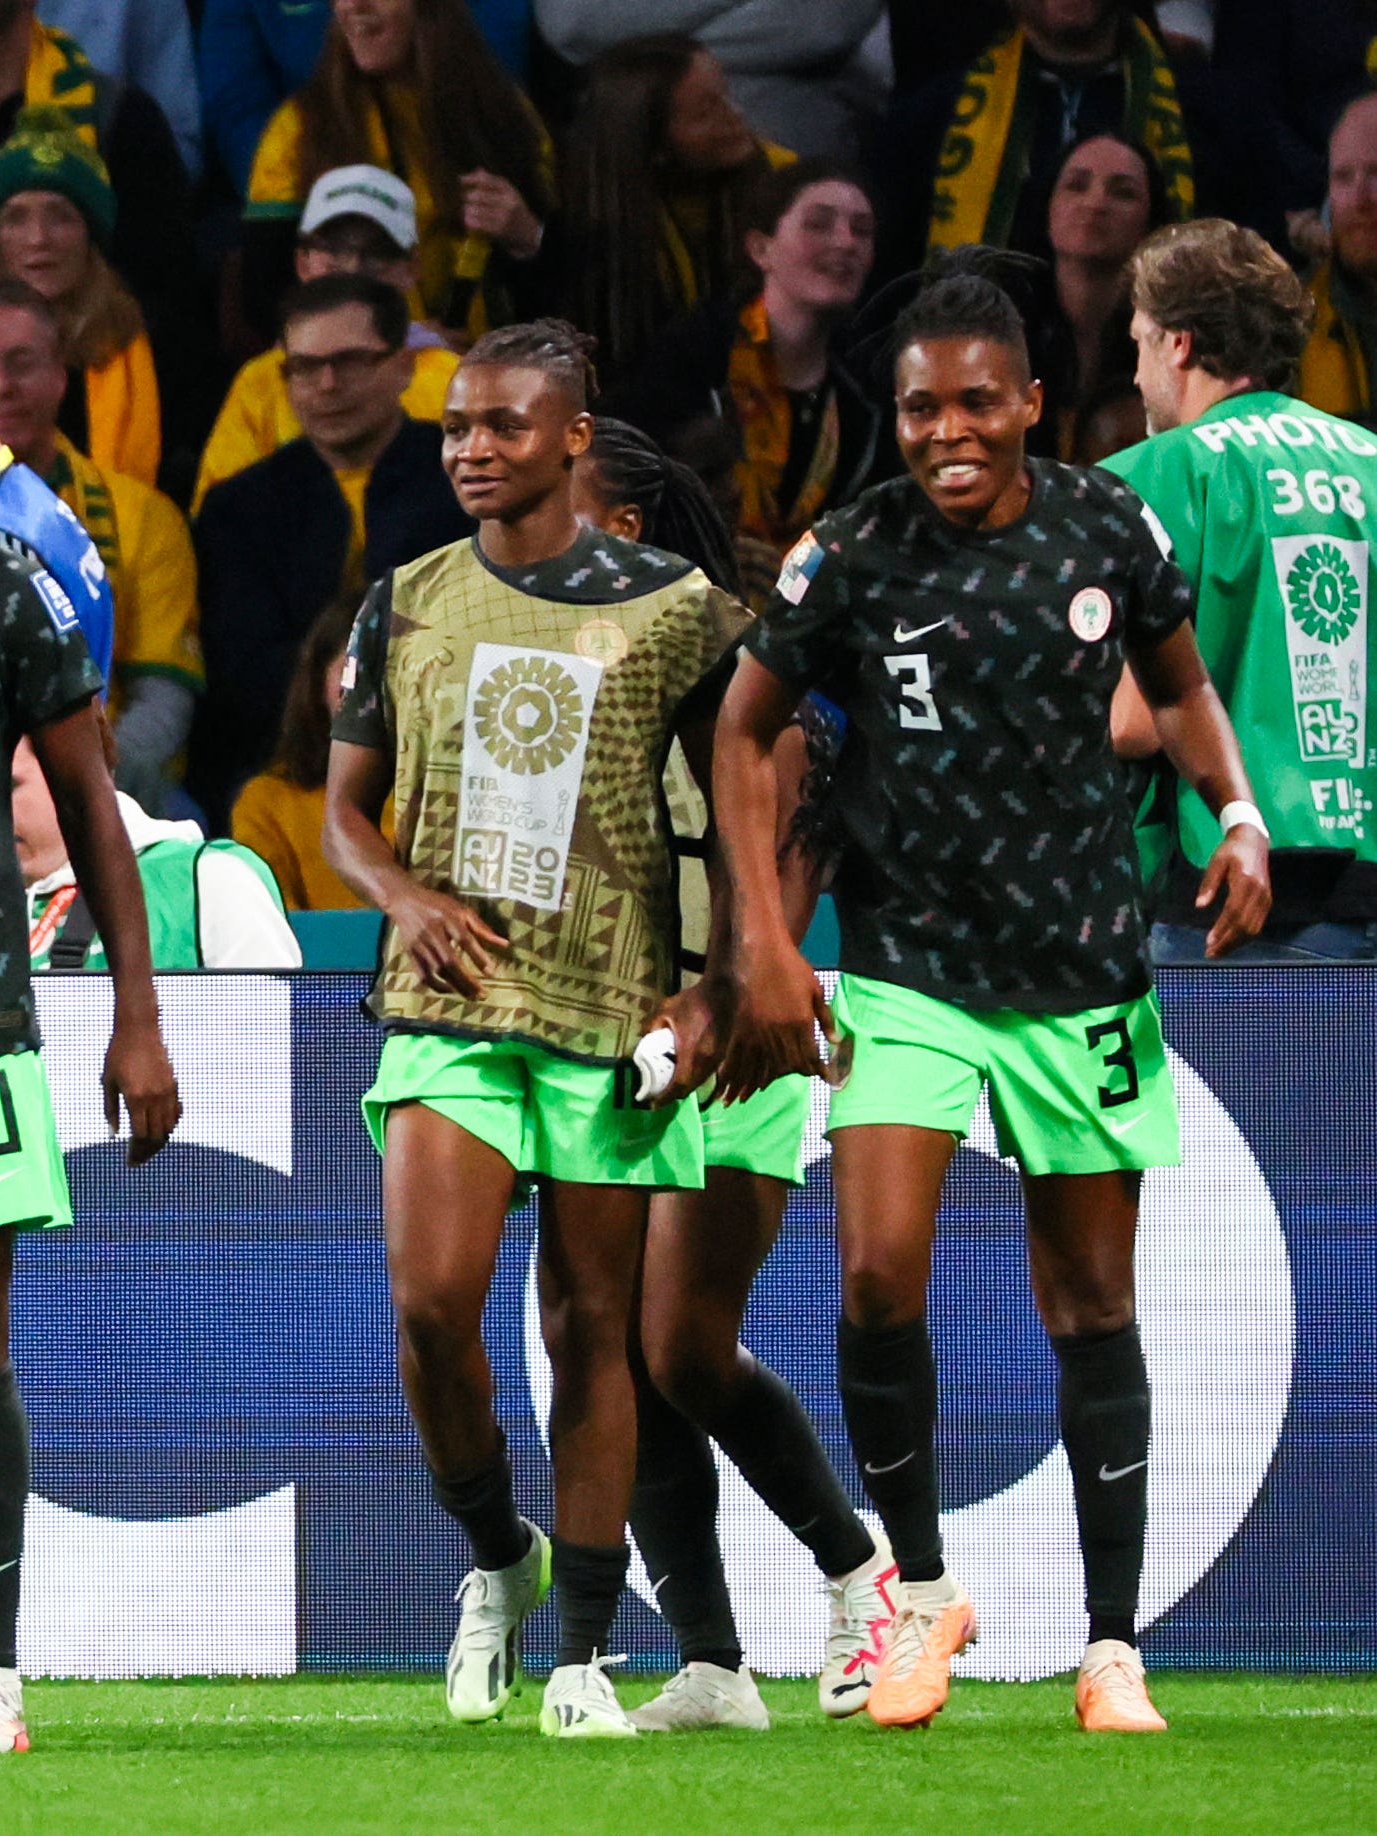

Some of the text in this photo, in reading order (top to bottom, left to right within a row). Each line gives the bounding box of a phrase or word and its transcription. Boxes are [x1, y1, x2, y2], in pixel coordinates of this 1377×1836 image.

[1266, 468, 1366, 520] 368
[1294, 653, 1331, 668] FIFA
[883, 654, 943, 731] 3
[463, 833, 503, 860] AU
[511, 840, 561, 873] 20
[508, 866, 557, 900] 23
[1085, 1017, 1139, 1109] 3
